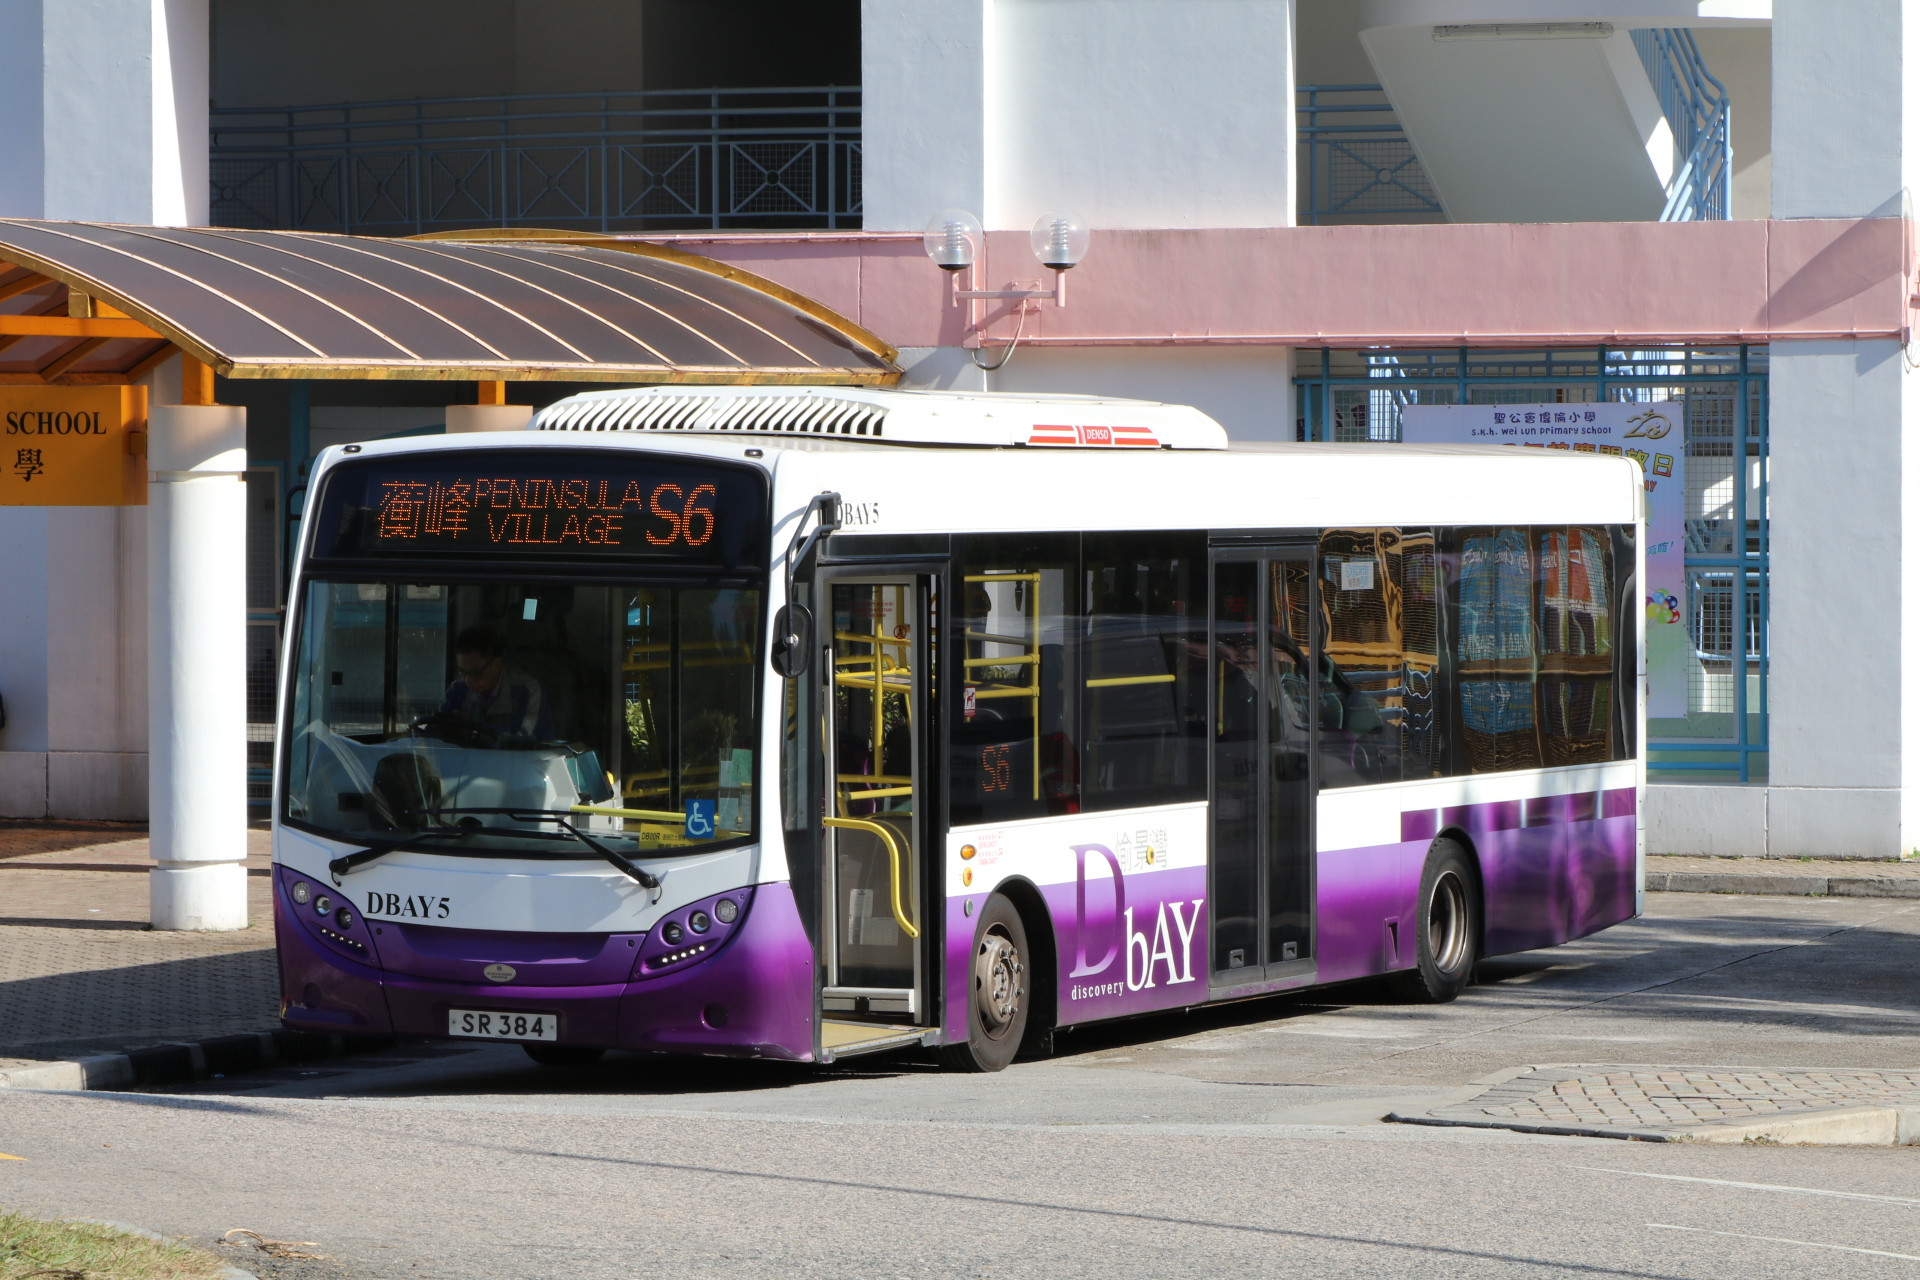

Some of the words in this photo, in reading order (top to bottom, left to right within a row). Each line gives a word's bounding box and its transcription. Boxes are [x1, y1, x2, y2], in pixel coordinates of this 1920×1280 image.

[6, 411, 107, 435] SCHOOL
[1086, 428, 1109, 440] DENSO
[474, 478, 643, 510] PENINSULA
[487, 513, 624, 545] VILLAGE
[645, 483, 716, 546] S6
[982, 744, 1010, 792] S6
[366, 891, 451, 919] DBAY5
[1071, 980, 1125, 1001] discovery
